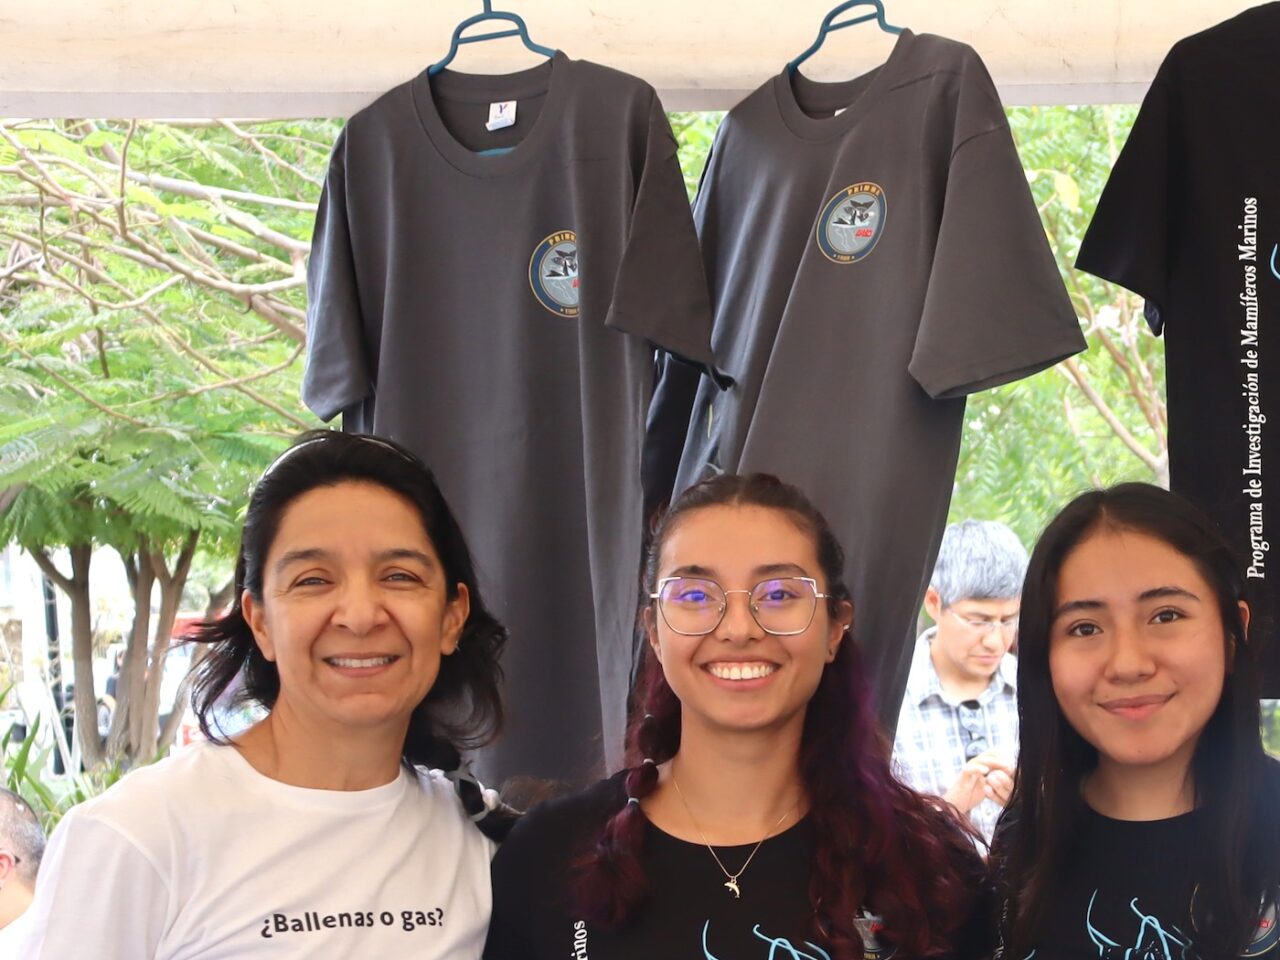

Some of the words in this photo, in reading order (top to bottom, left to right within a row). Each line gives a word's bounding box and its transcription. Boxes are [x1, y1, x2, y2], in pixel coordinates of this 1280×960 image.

[1237, 198, 1258, 261] Marinos
[1239, 266, 1259, 346] Mamíferos
[1240, 350, 1259, 369] de
[1242, 373, 1267, 476] Investigación
[1242, 480, 1263, 499] de
[1246, 503, 1270, 579] Programa
[261, 911, 374, 938] ¿Ballenas
[380, 911, 394, 926] o
[401, 908, 444, 931] gas?
